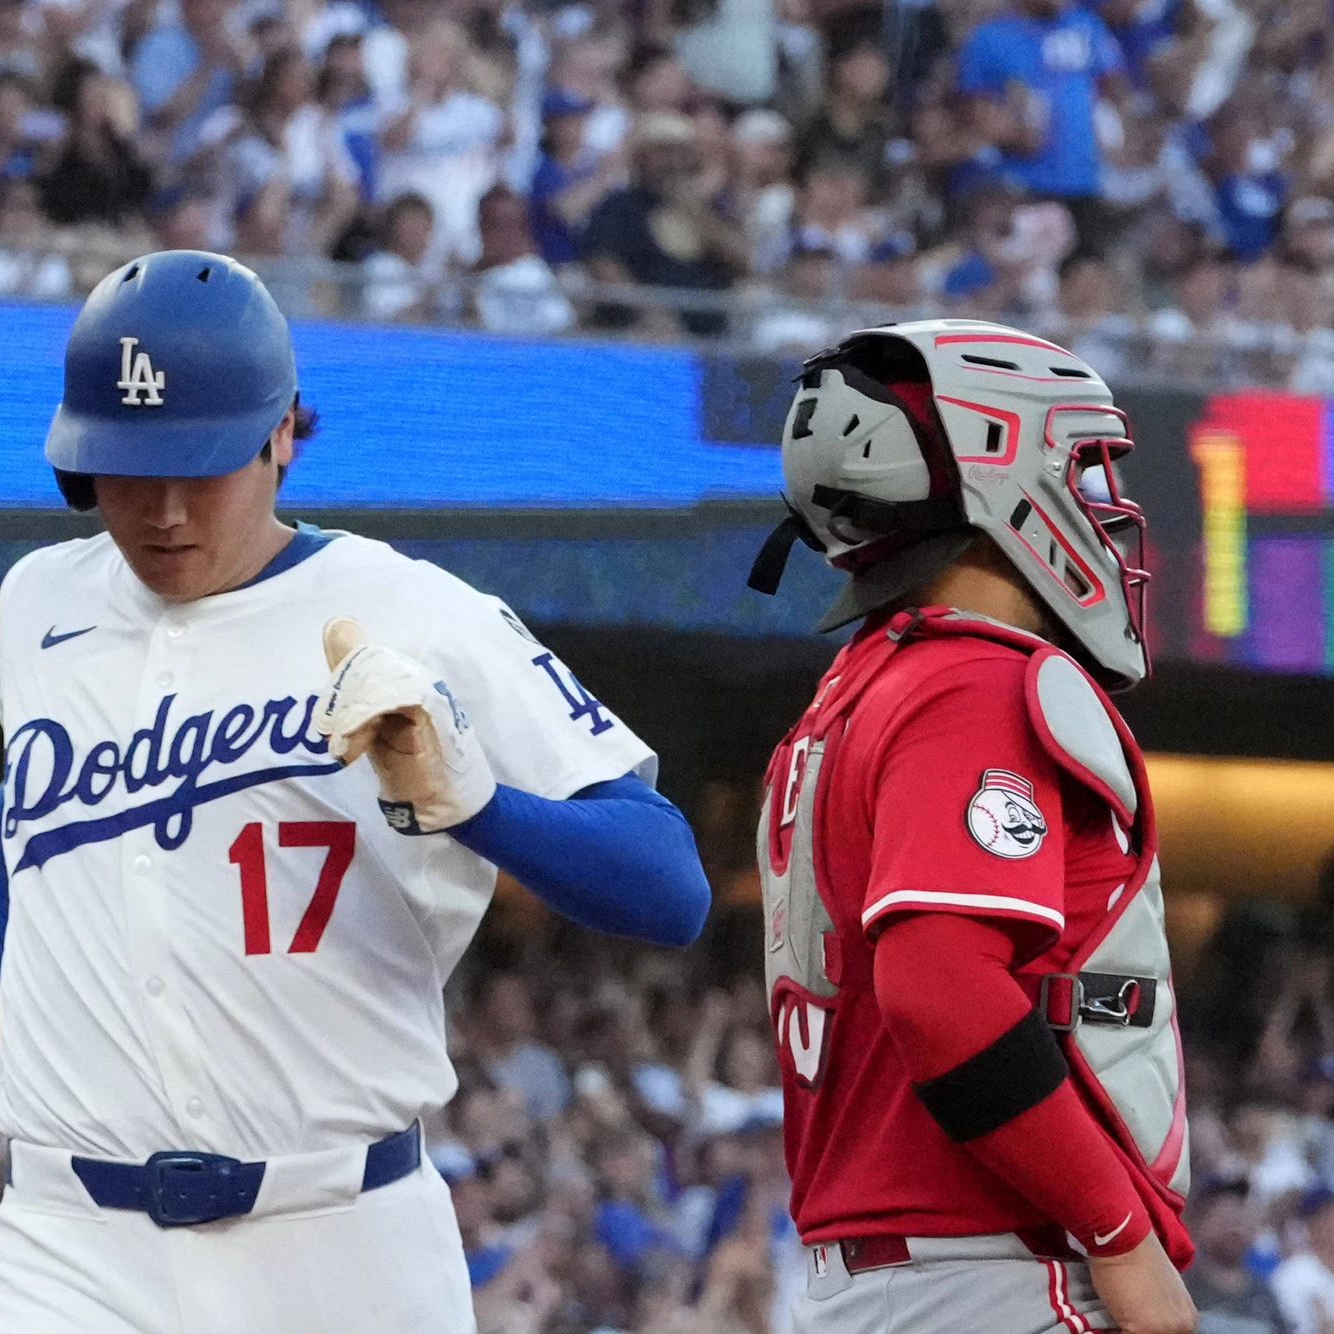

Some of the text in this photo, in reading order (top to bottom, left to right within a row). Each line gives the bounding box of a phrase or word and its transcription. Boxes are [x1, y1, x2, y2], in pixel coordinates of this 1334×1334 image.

[117, 336, 165, 406] LA
[1191, 430, 1249, 638] 1
[229, 822, 357, 957] 17
